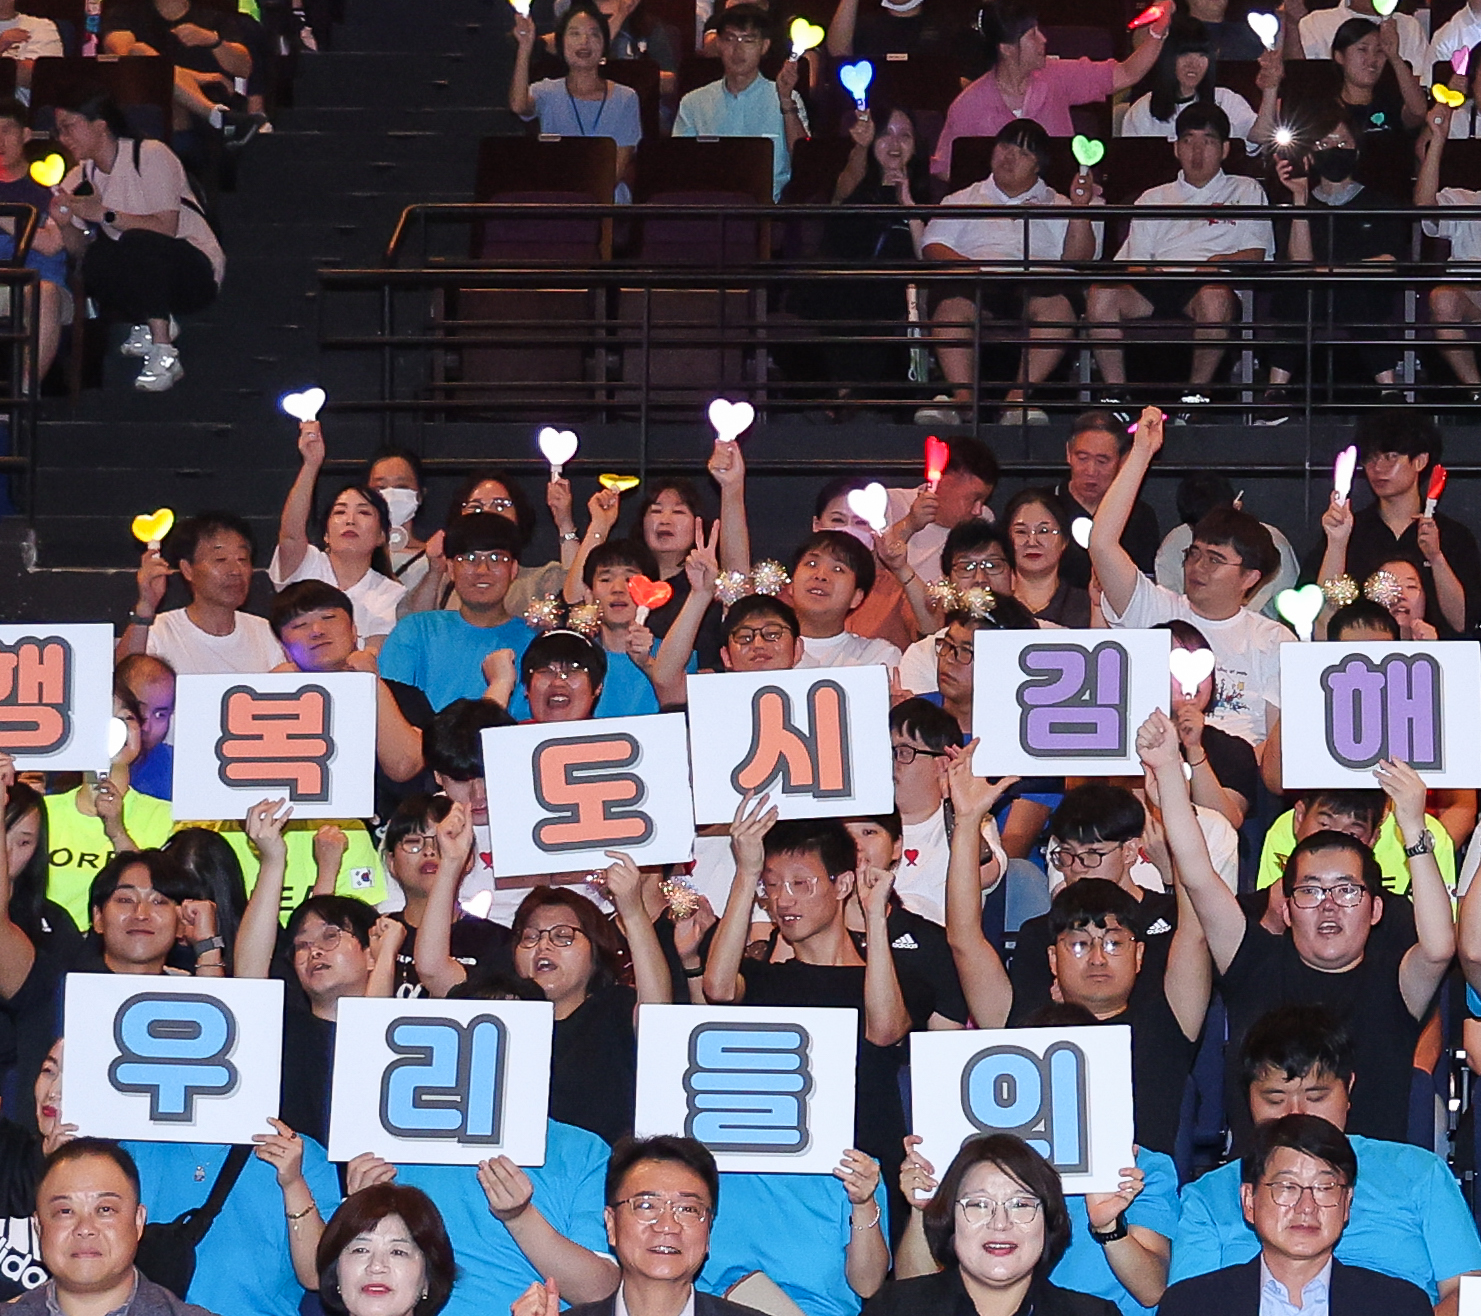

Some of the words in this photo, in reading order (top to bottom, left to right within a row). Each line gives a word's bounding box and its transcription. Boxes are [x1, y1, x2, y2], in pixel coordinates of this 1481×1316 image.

[215, 684, 334, 802] 복
[532, 733, 653, 852] 도
[730, 679, 851, 798] 시
[1016, 641, 1128, 757] 김
[1322, 652, 1443, 771] 해
[108, 992, 237, 1122] 우
[379, 1014, 507, 1144] 리
[683, 1022, 813, 1153] 들
[961, 1041, 1088, 1165] 의
